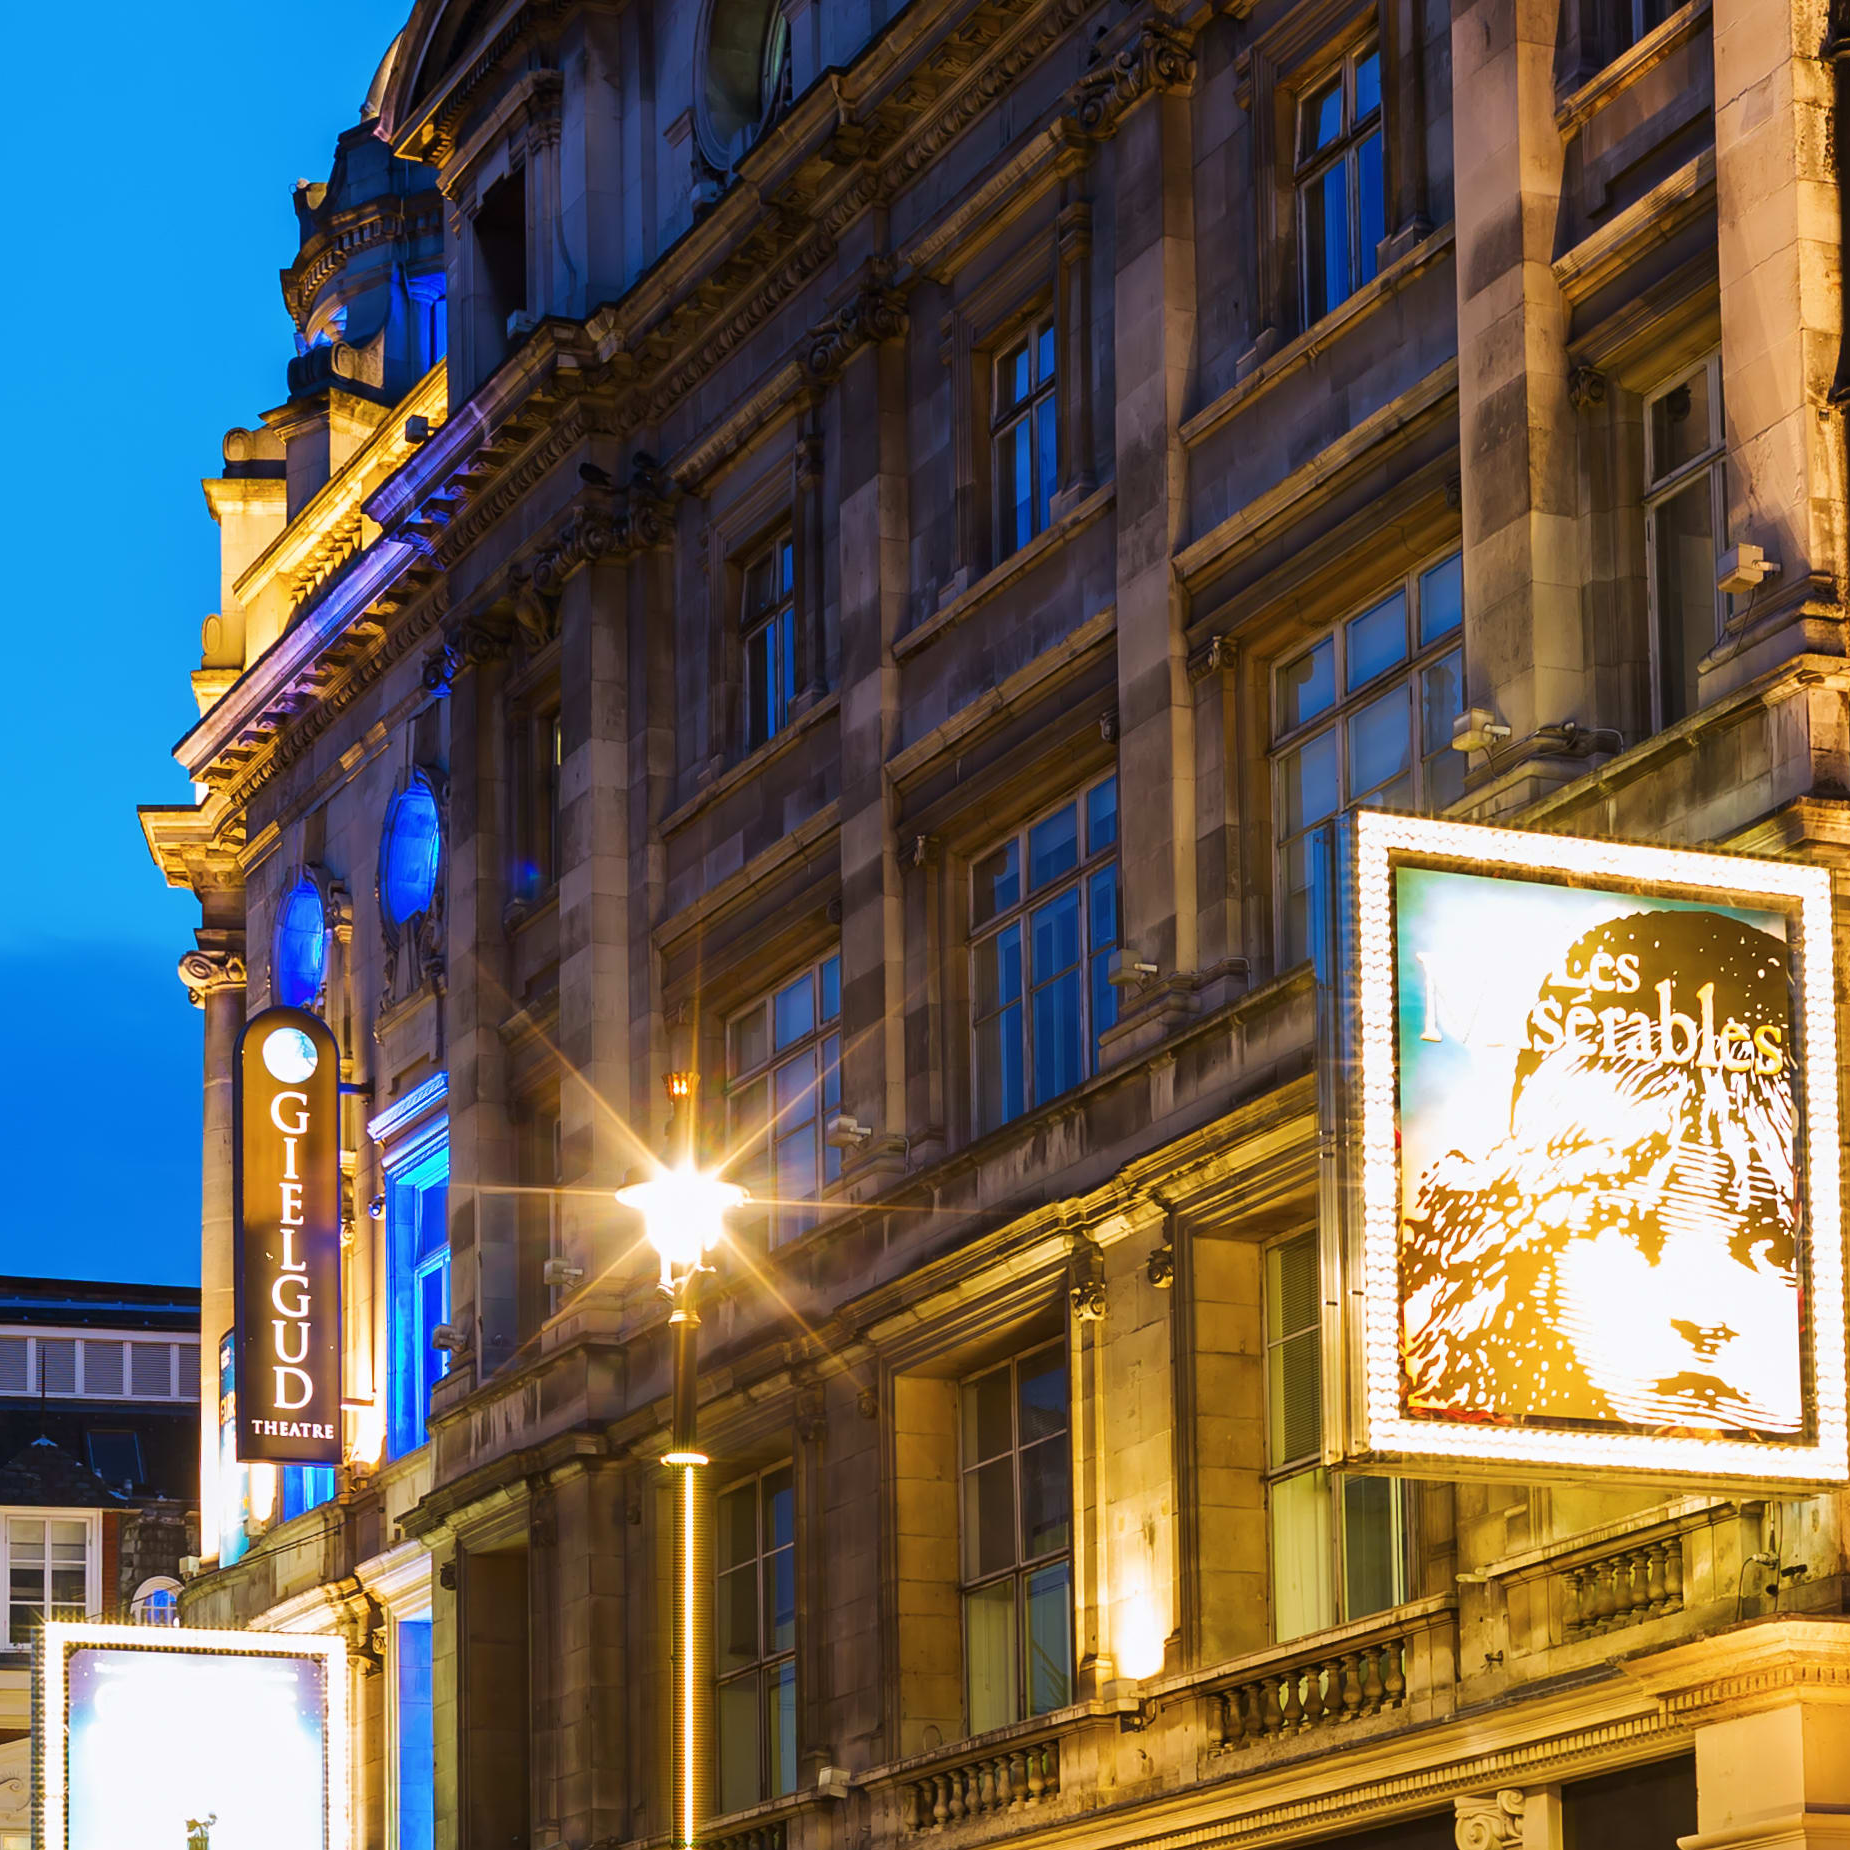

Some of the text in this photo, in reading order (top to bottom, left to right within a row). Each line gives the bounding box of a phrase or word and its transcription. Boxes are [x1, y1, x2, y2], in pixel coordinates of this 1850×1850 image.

[1549, 952, 1640, 993] Les
[1416, 953, 1783, 1075] Msérables
[270, 1092, 313, 1409] GIELGUD
[252, 1420, 334, 1440] THEATRE
